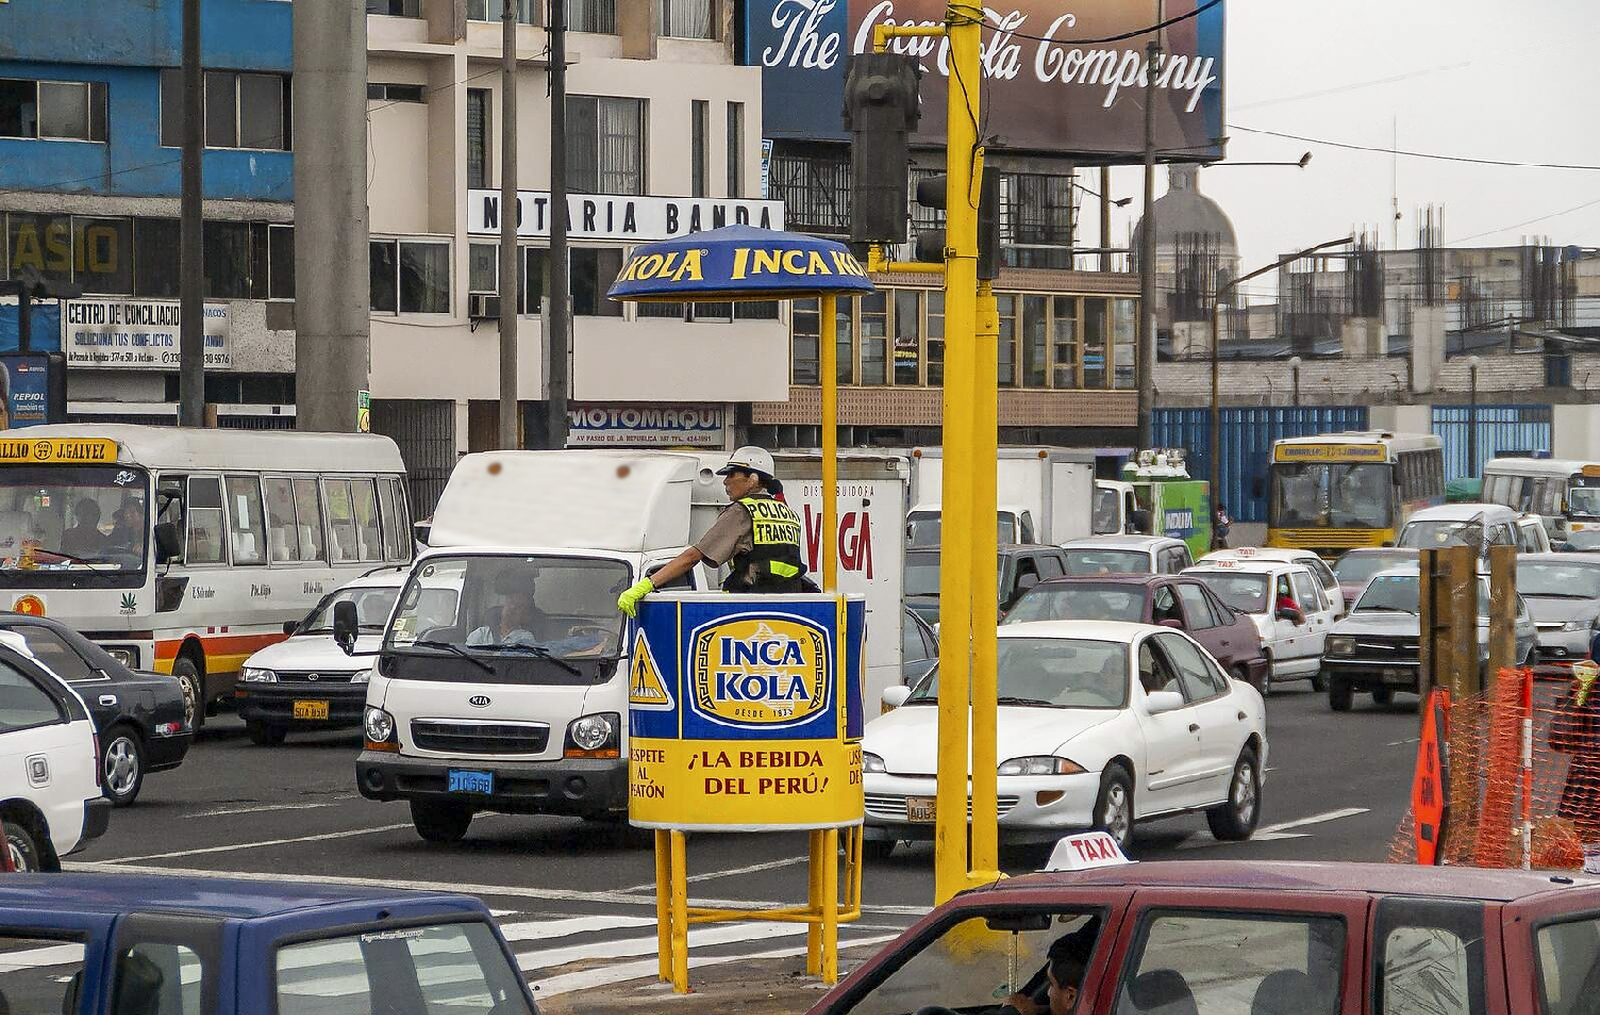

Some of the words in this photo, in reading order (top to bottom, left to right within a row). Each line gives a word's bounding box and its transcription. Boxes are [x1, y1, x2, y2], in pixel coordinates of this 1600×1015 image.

[763, 0, 838, 72] The
[666, 203, 771, 234] BANDA
[731, 248, 832, 280] INCA
[68, 303, 105, 325] CENTRO
[109, 304, 121, 325] DE
[74, 332, 113, 346] SOLUCIONA
[114, 332, 129, 347] TUS
[131, 333, 174, 347] CONFLICTOS
[0, 443, 29, 458] LLAO
[803, 503, 873, 579] VGA
[1239, 548, 1255, 556] TAXI
[720, 636, 807, 666] INCA
[715, 672, 811, 702] KOLA
[734, 708, 764, 718] DESDE
[688, 750, 732, 770] ¡LA
[739, 750, 824, 768] BEBIDA
[637, 766, 649, 780] AL
[704, 777, 750, 795] DEL
[759, 773, 829, 795] PERÚ!
[1070, 837, 1119, 862] TAXI
